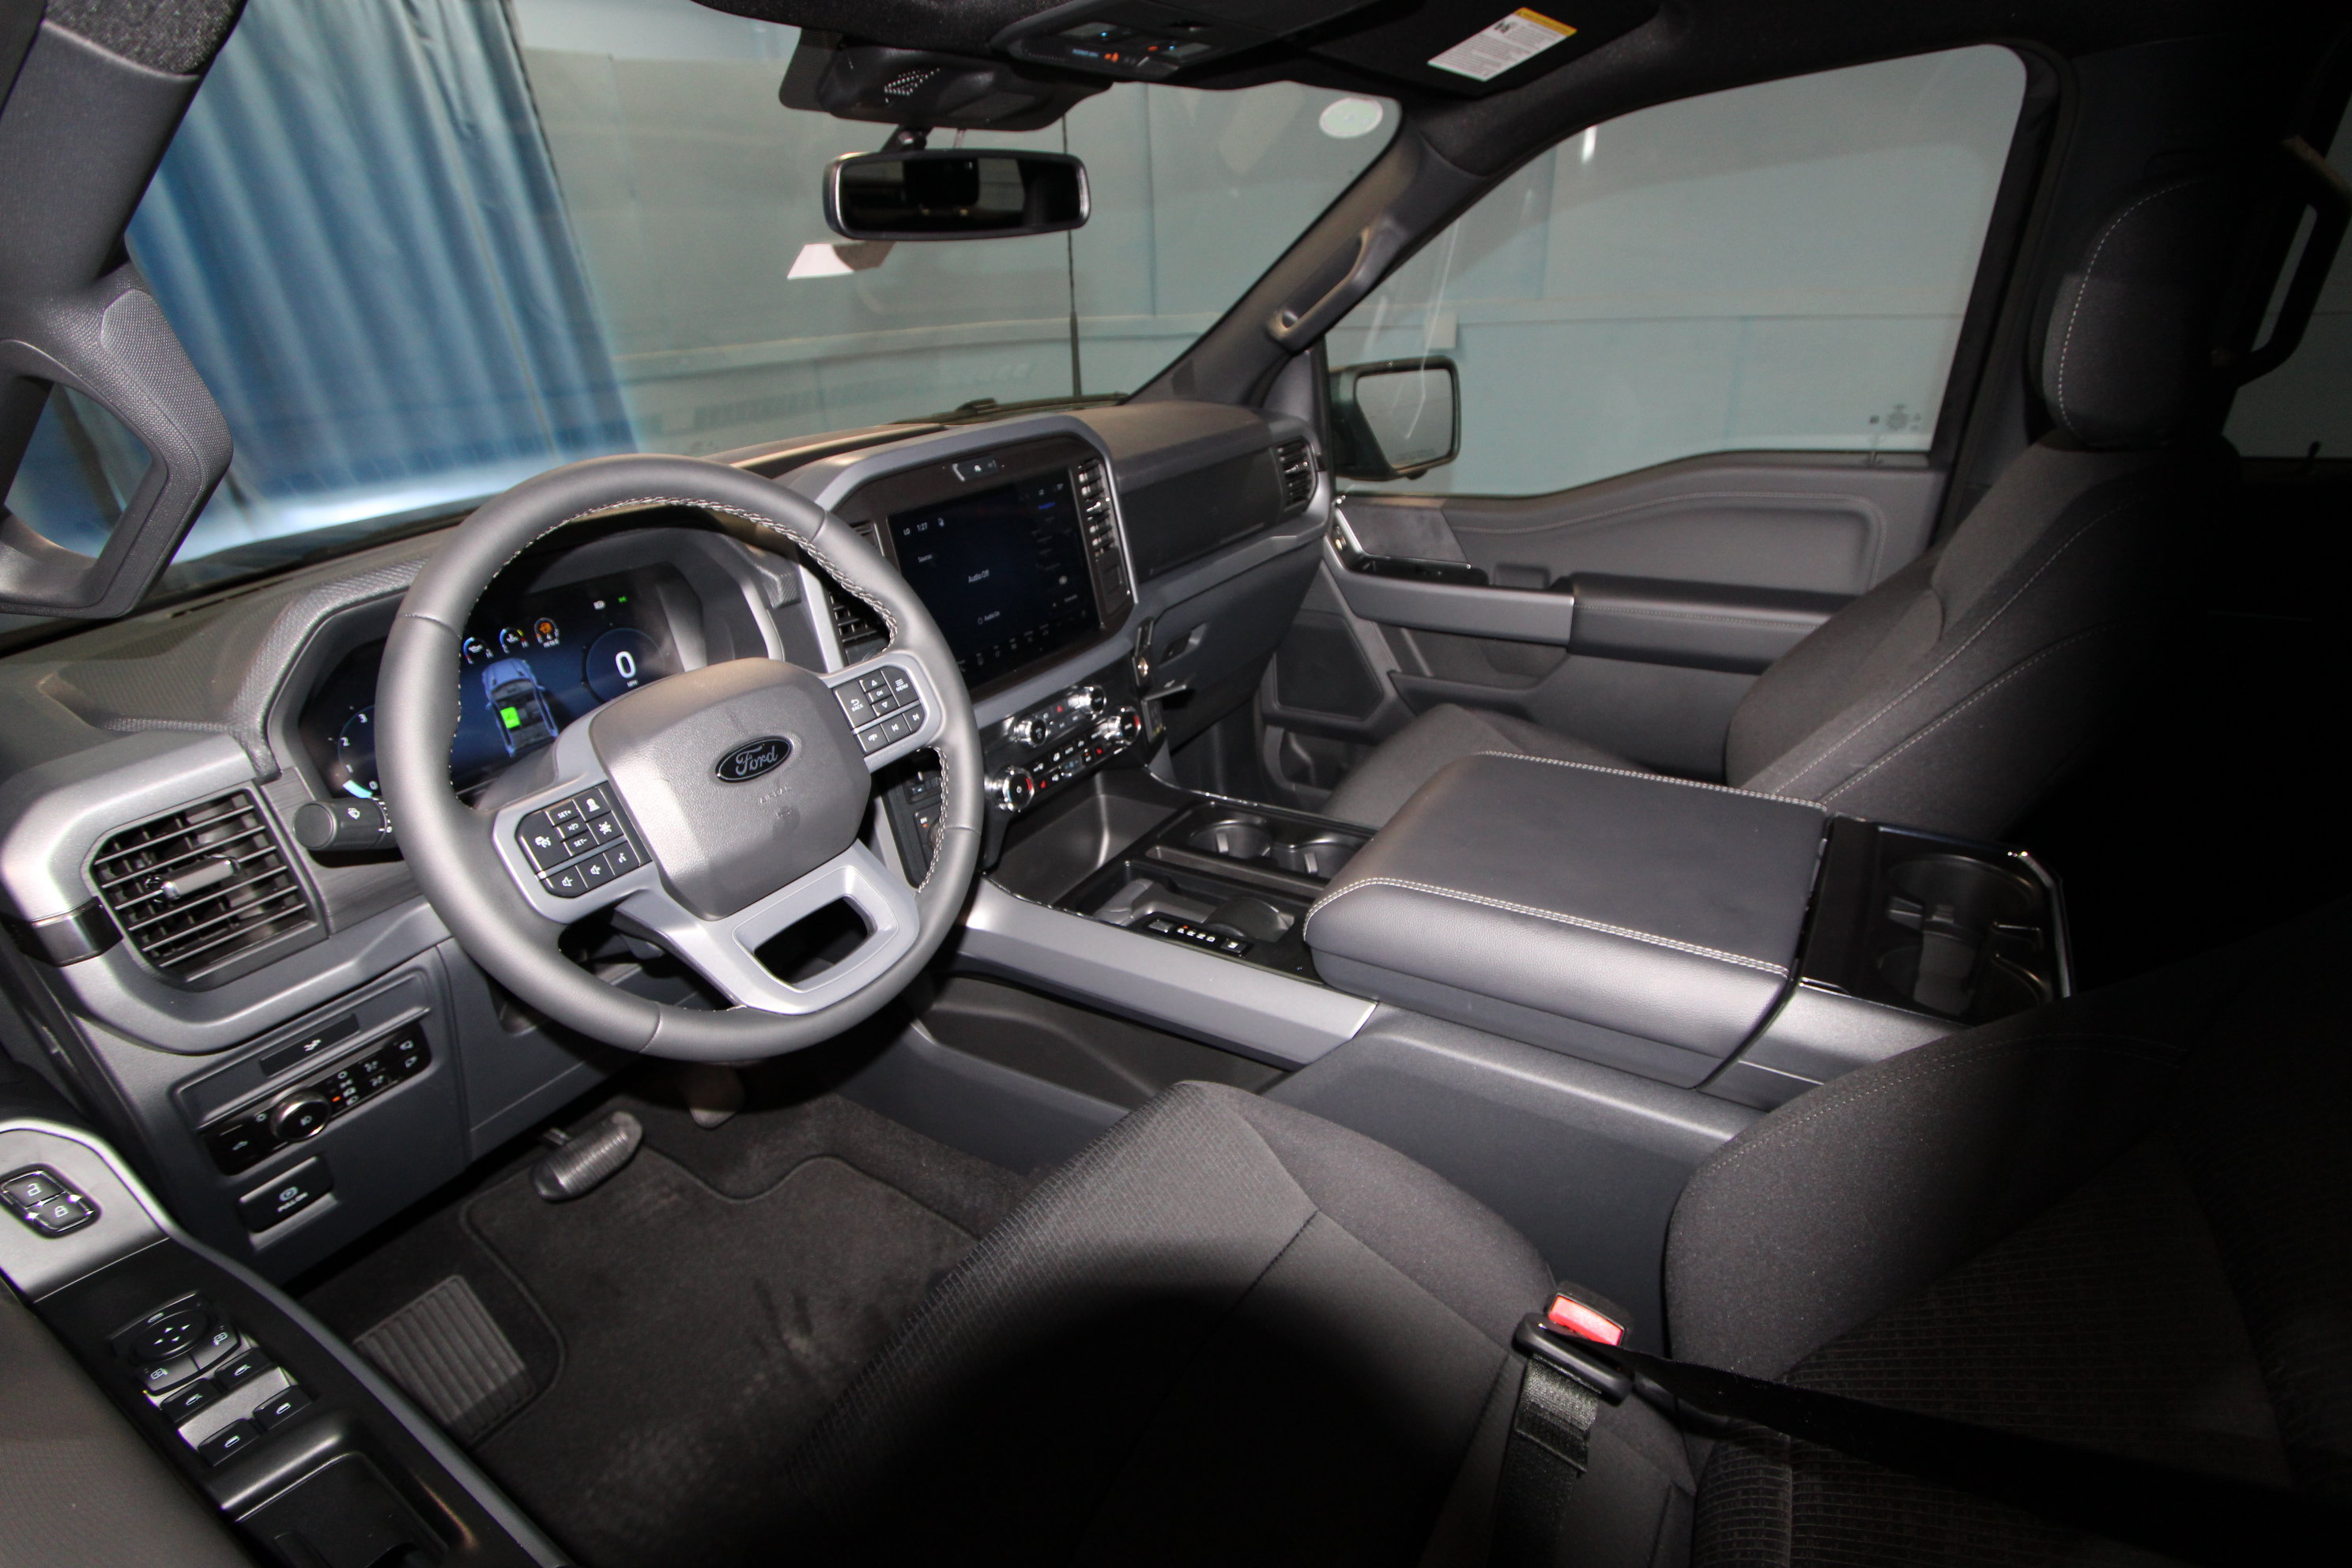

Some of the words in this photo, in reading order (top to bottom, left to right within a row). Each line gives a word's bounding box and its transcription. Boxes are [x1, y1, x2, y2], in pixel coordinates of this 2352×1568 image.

[917, 522, 928, 531] 1:27
[616, 651, 636, 679] 0
[895, 683, 908, 692] MENU
[851, 703, 864, 712] BACK
[358, 713, 368, 723] 3
[341, 737, 351, 747] 2
[735, 745, 778, 775] Ford
[346, 763, 354, 773] 1
[368, 780, 379, 790] 0
[557, 809, 571, 819] SET+
[573, 839, 587, 847] SET-
